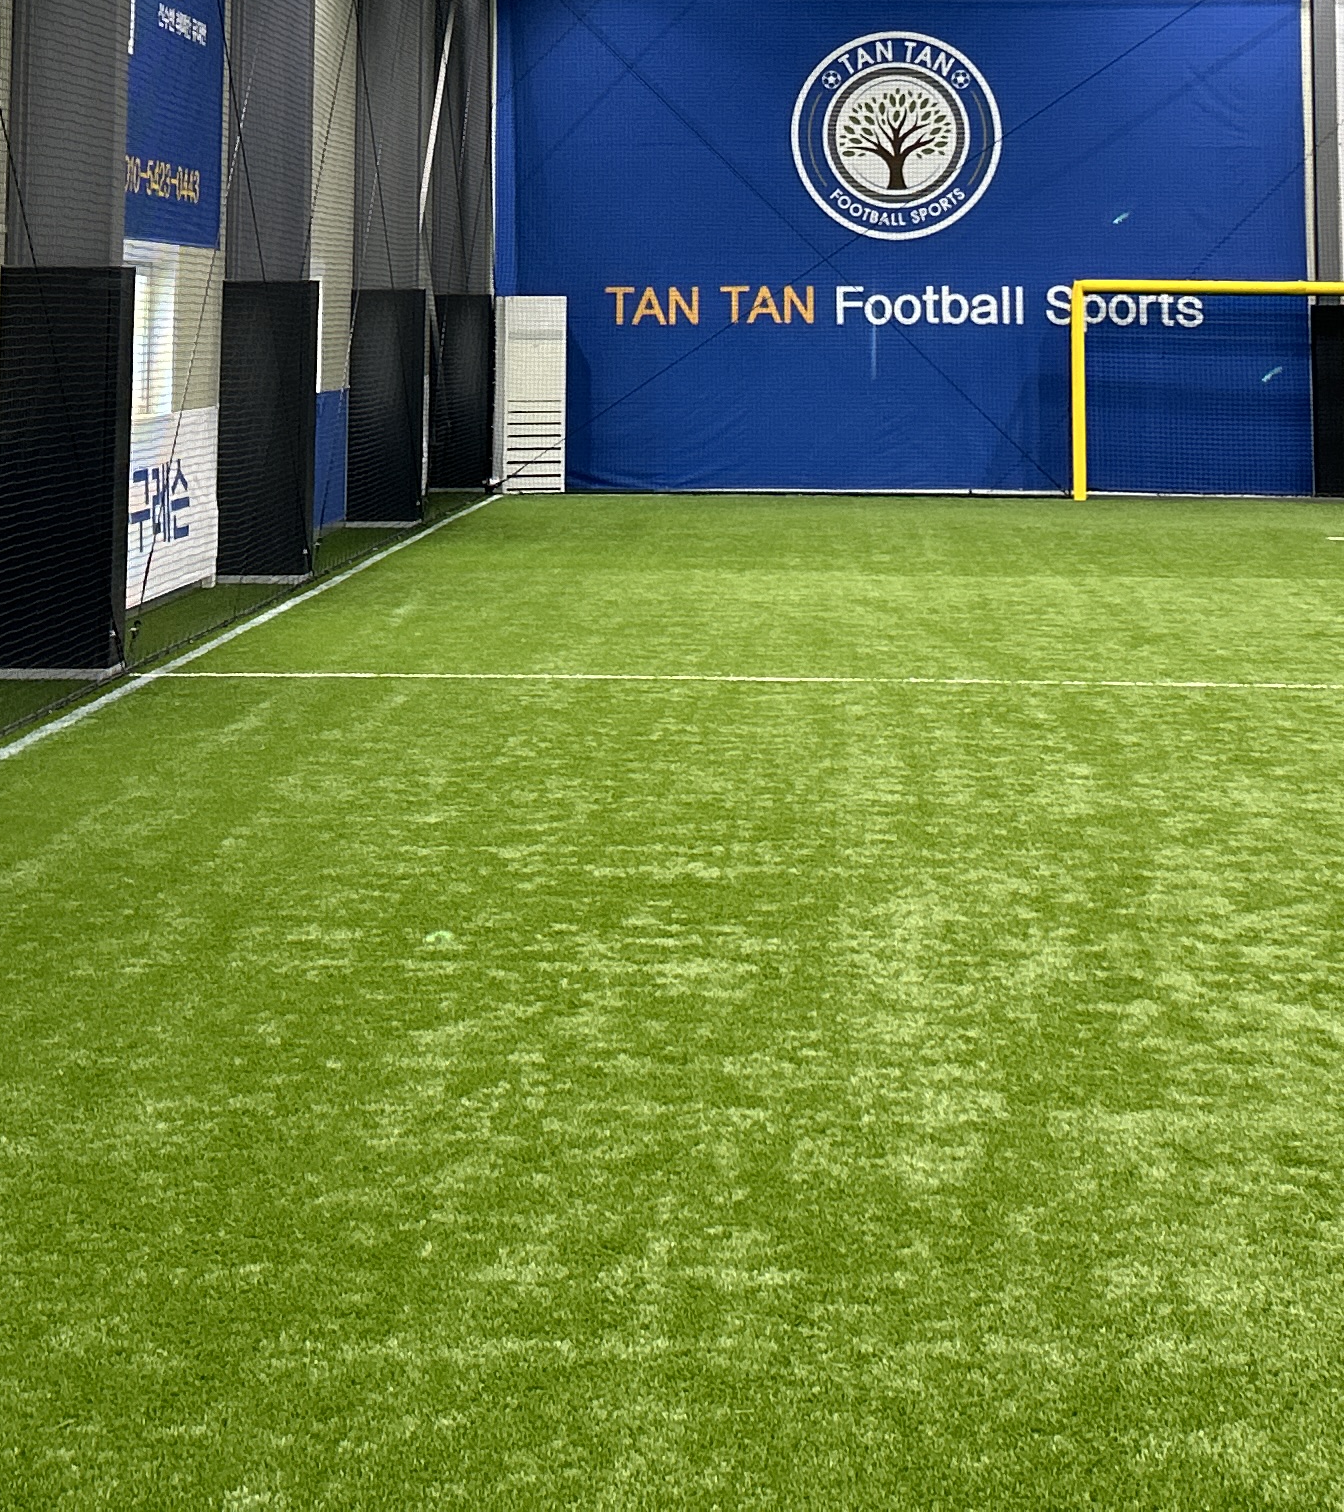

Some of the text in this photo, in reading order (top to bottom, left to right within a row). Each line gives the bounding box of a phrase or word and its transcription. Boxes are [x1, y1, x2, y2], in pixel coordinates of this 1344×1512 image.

[838, 40, 956, 77] TAN TAN
[830, 188, 966, 227] FOOTBALL SPORTS
[605, 285, 1204, 334] TAN TAN Football Sports
